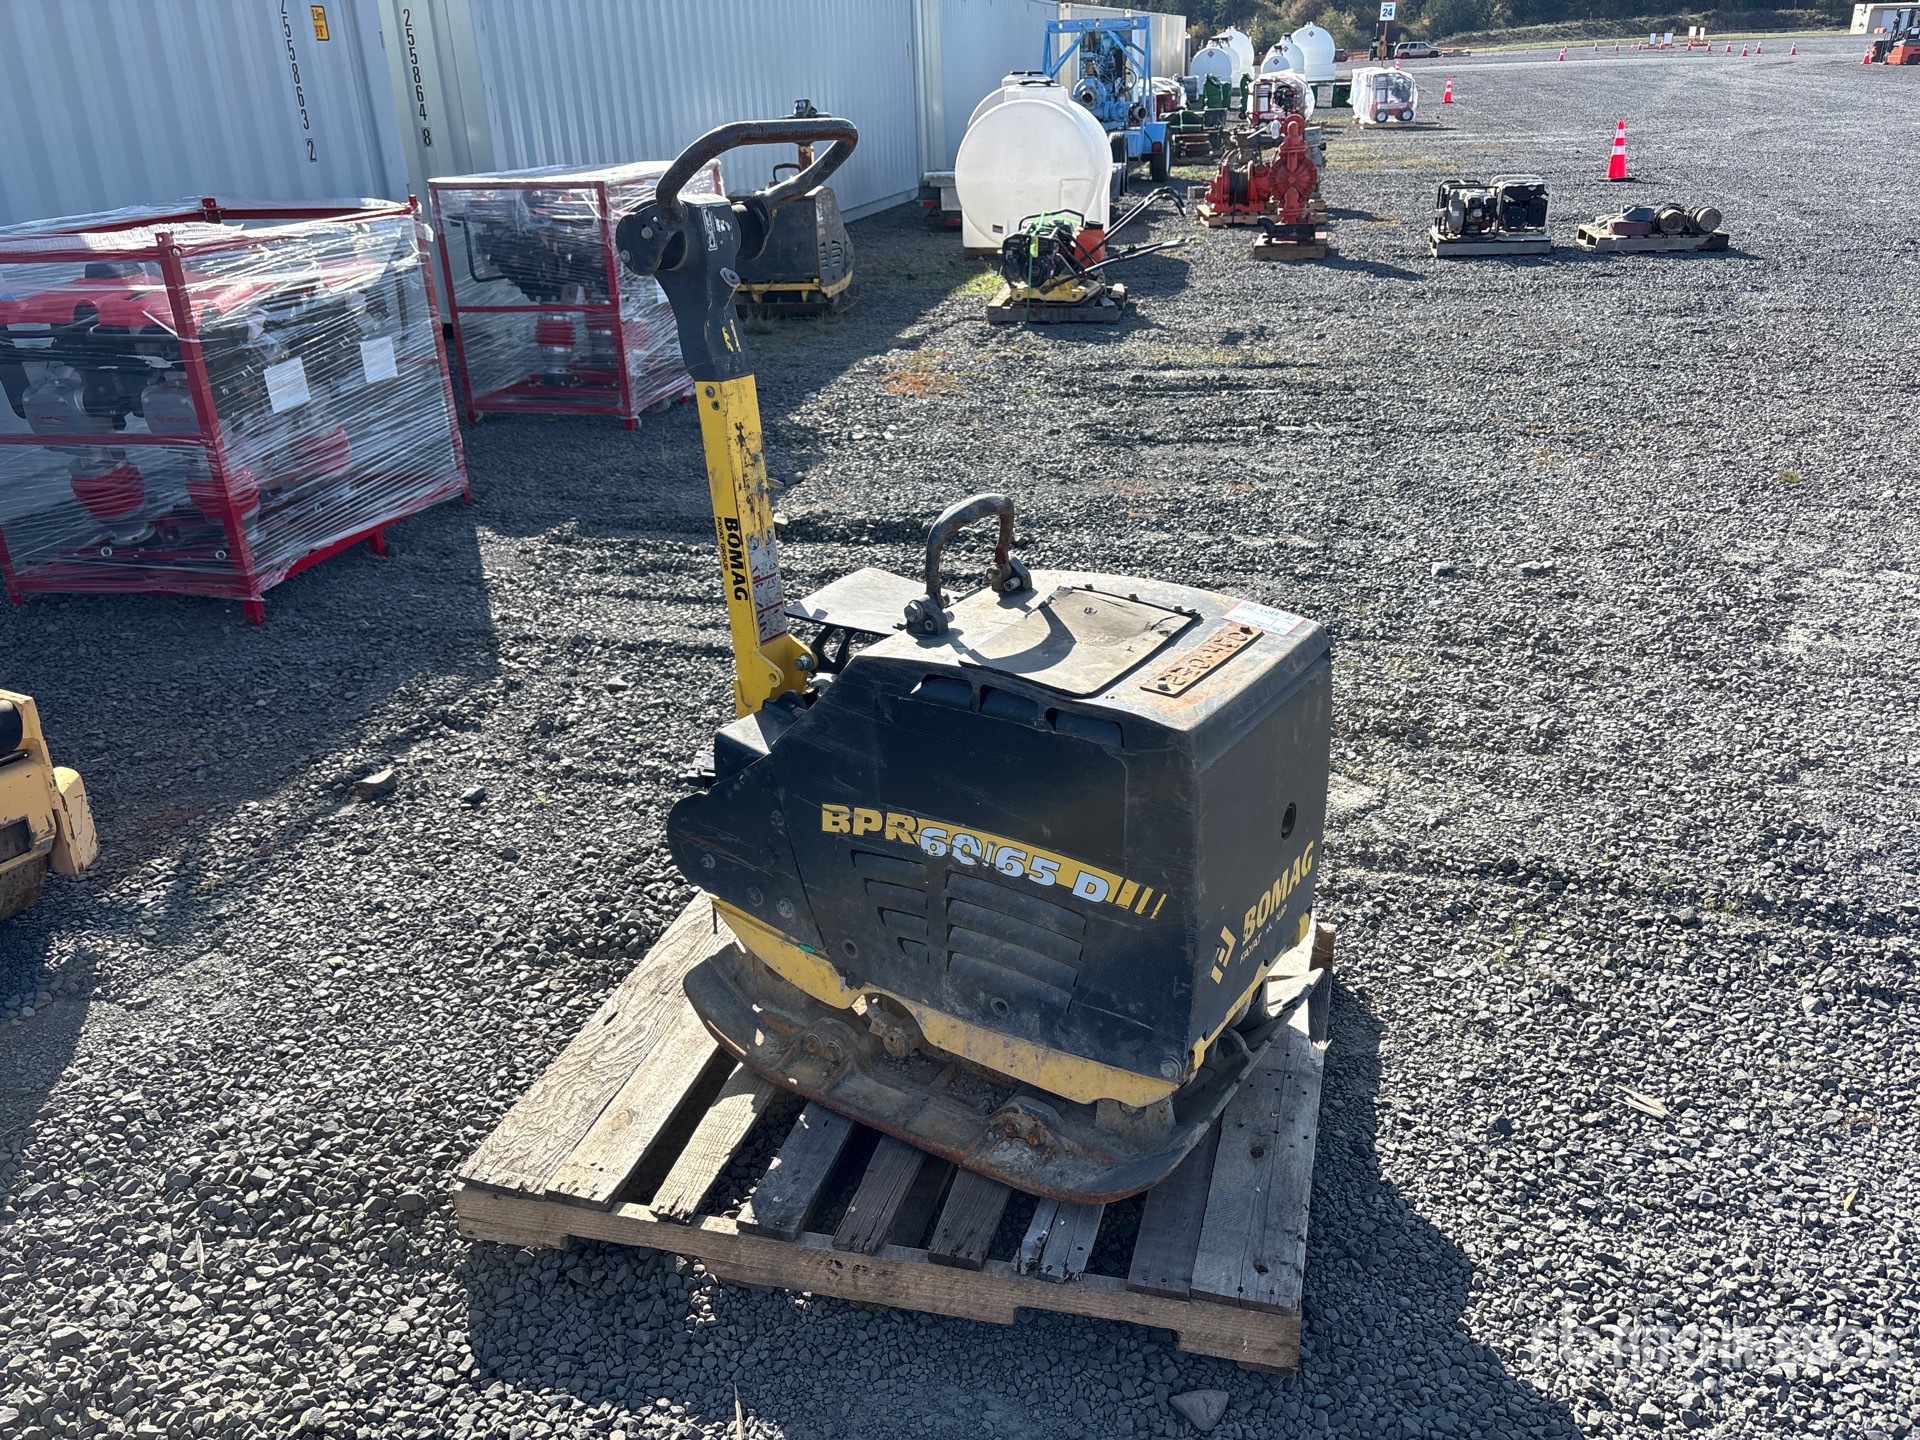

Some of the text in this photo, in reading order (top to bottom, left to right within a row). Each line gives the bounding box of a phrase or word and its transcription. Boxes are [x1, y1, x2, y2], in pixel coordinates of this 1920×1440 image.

[1382, 8, 1393, 17] 24
[280, 0, 317, 161] 255863 2
[403, 8, 432, 146] 255864 8
[716, 516, 724, 541] FAYAT
[724, 517, 748, 601] BOMAG
[1072, 870, 1110, 903] D
[1242, 840, 1314, 947] BOMAG
[1239, 931, 1262, 965] FAYAT
